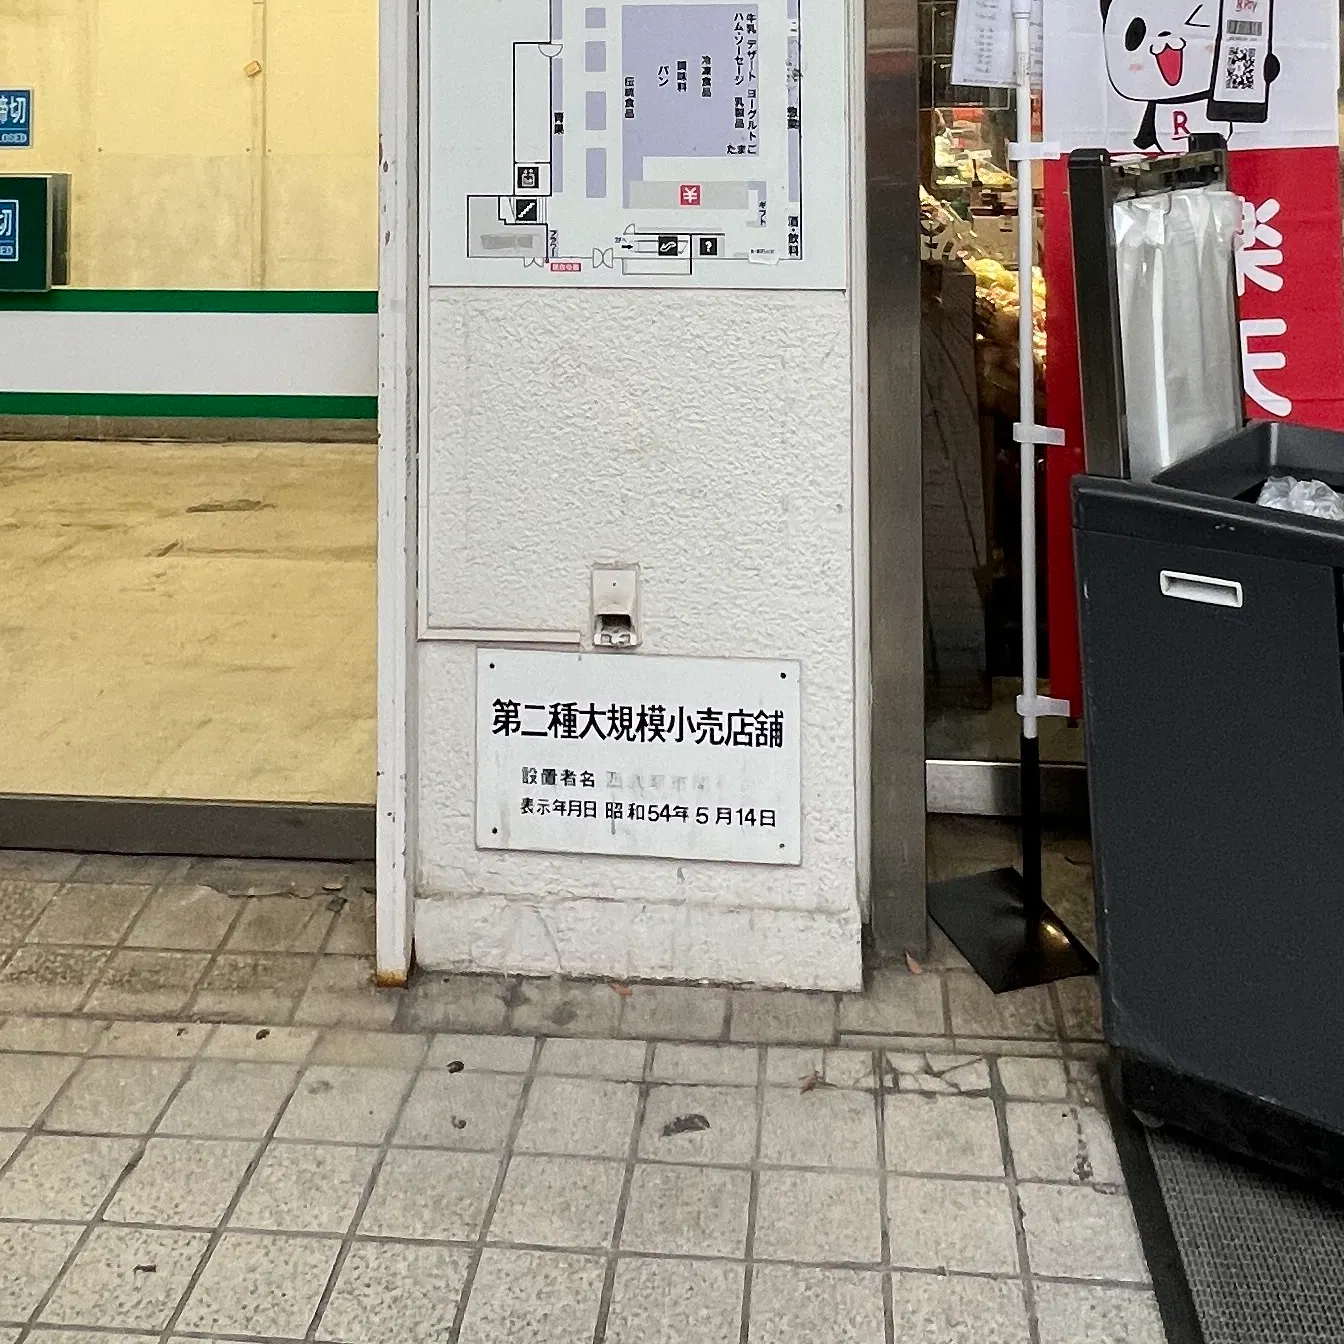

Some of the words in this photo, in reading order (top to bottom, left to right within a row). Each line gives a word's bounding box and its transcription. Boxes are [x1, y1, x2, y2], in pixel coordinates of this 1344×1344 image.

[658, 65, 670, 88] パン
[1173, 110, 1189, 135] R
[492, 698, 784, 749] 第二種大規模小売店舗
[521, 766, 596, 789] 設置者名
[520, 798, 598, 820] 表示年月日
[605, 800, 777, 828] 昭和54年5月14日
